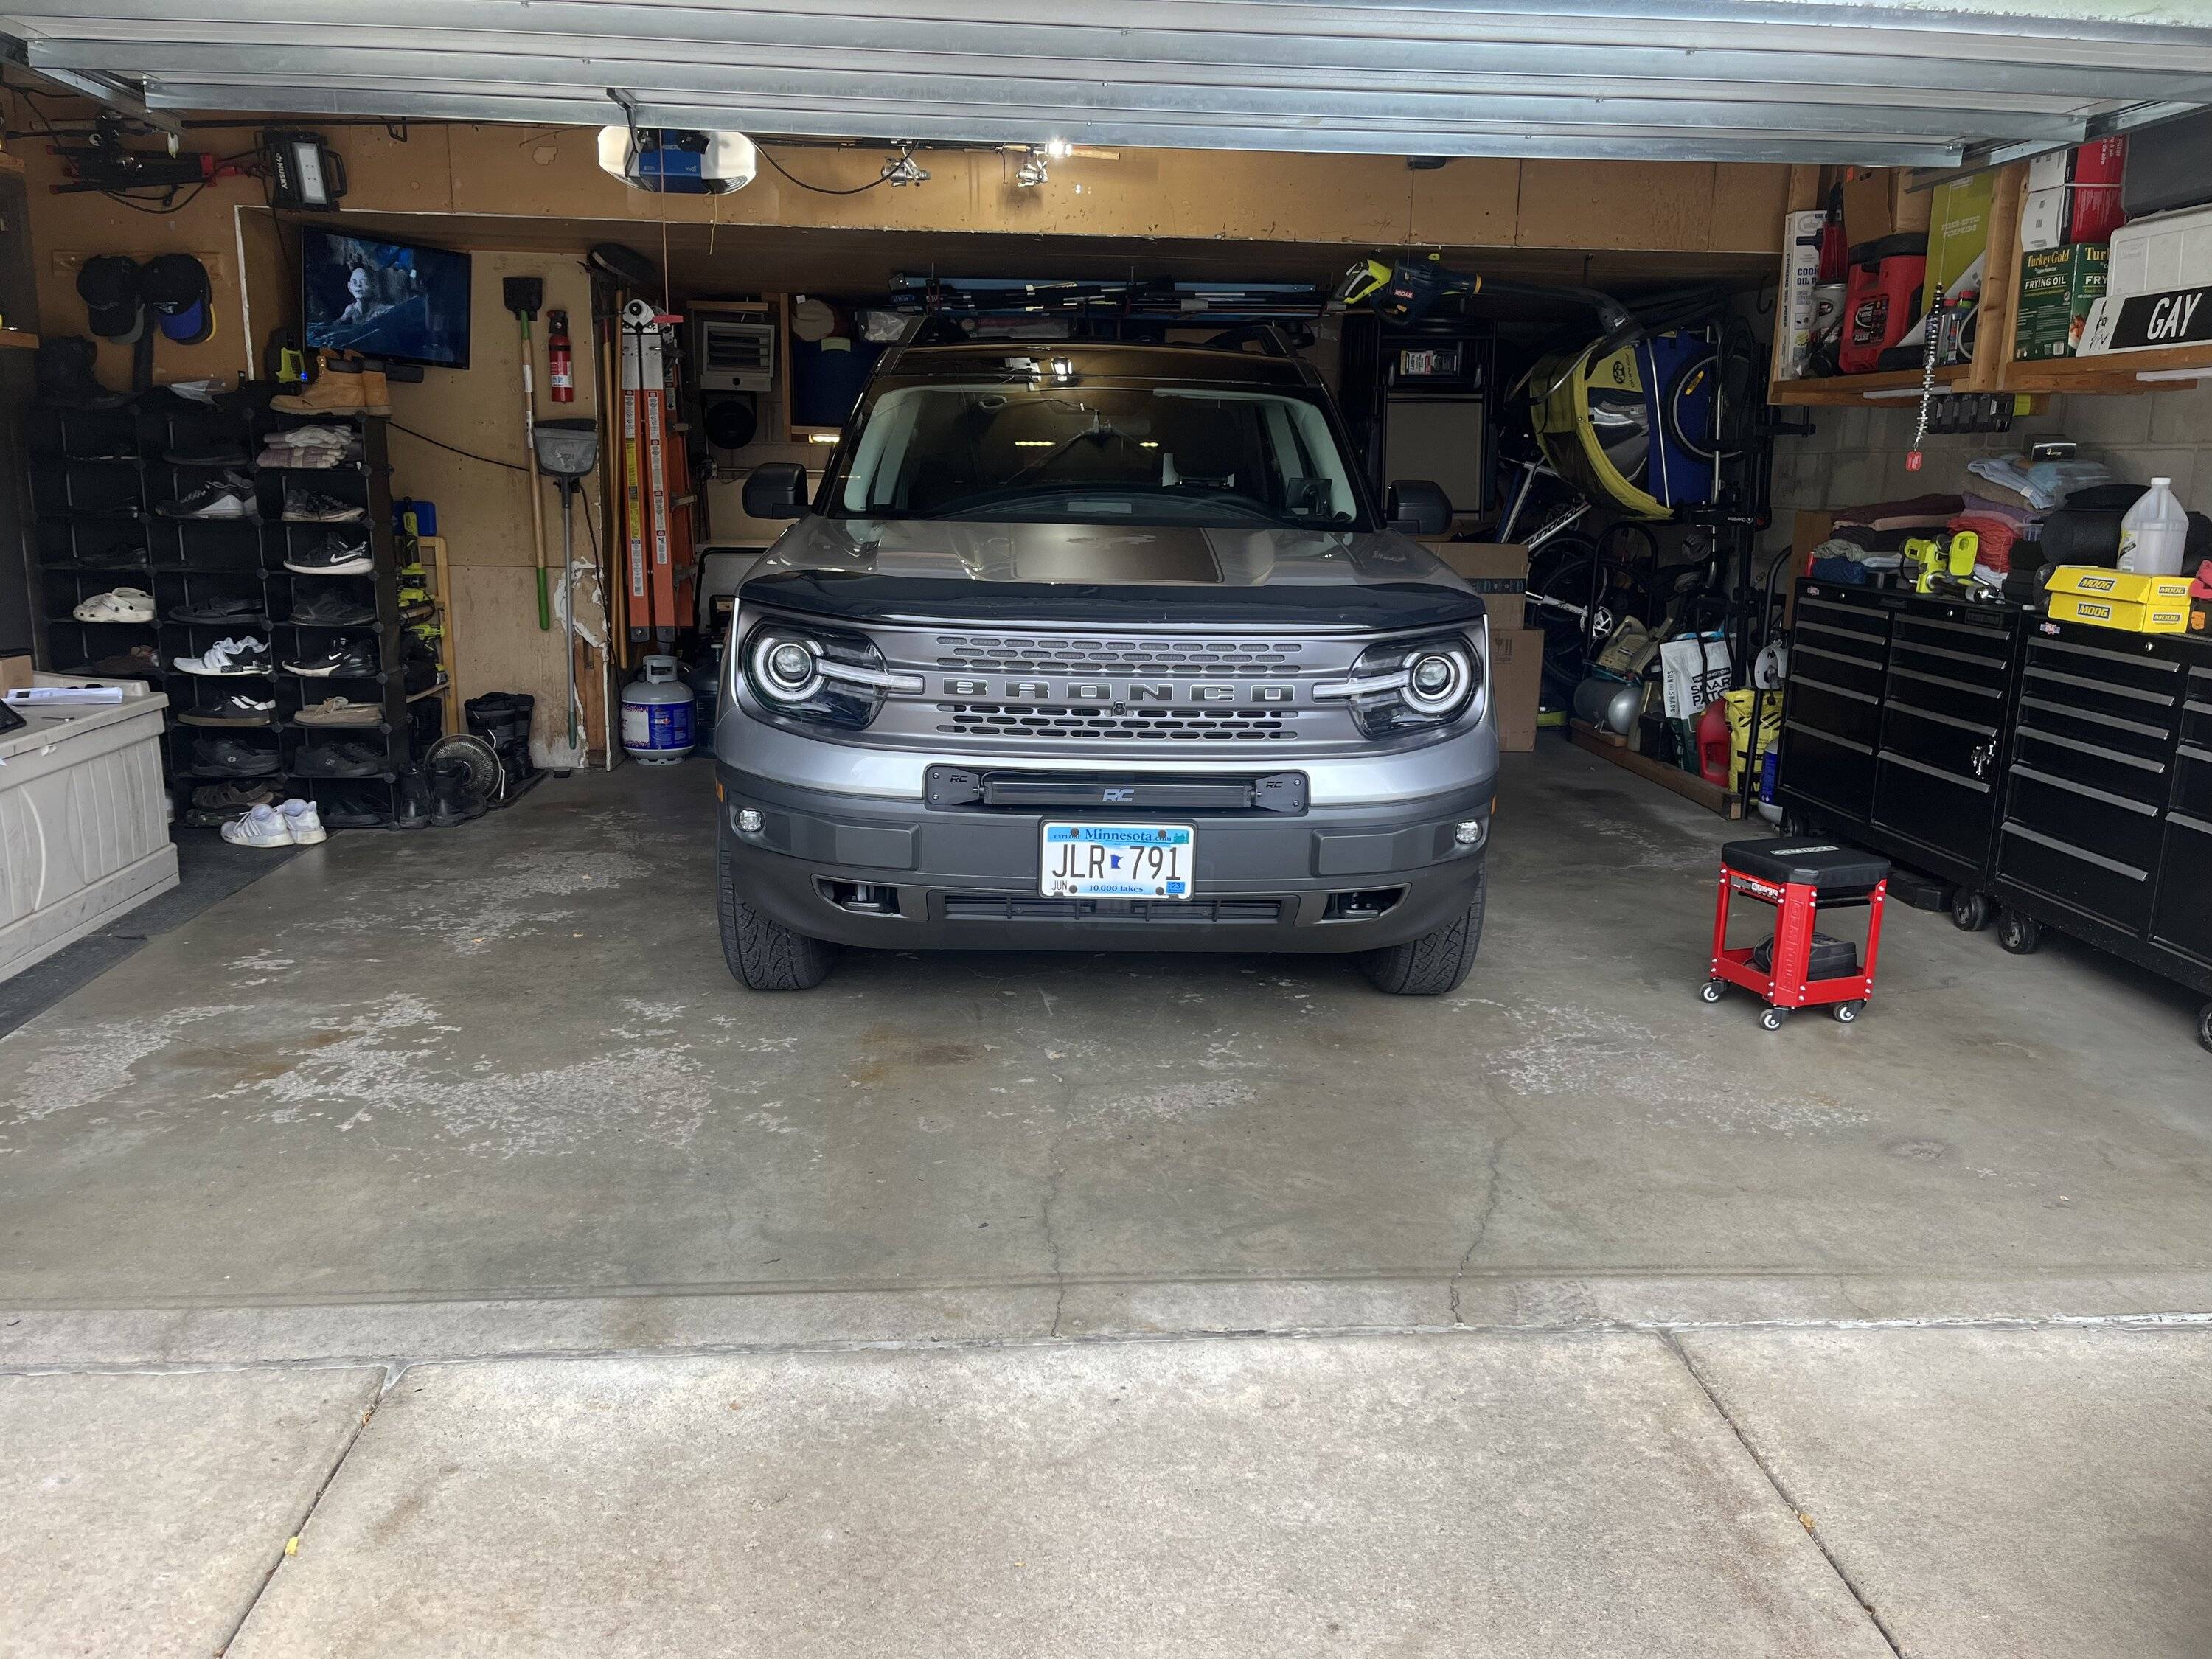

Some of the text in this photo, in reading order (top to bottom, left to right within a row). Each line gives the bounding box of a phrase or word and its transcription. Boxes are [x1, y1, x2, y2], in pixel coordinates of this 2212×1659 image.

[277, 161, 288, 189] HUSKY
[2028, 249, 2070, 267] Turkey Gold
[2025, 276, 2066, 290] FRYING OIL
[2147, 293, 2203, 340] GAY
[2081, 578, 2114, 589] MOOG
[2079, 605, 2109, 617] MOOG
[943, 678, 1295, 702] BRONCO
[950, 774, 968, 782] RC
[1265, 780, 1284, 788] RC
[1102, 788, 1135, 802] RC
[1085, 828, 1152, 841] Minnesota
[1052, 844, 1180, 880] JLR 791
[1051, 880, 1068, 891] JUN
